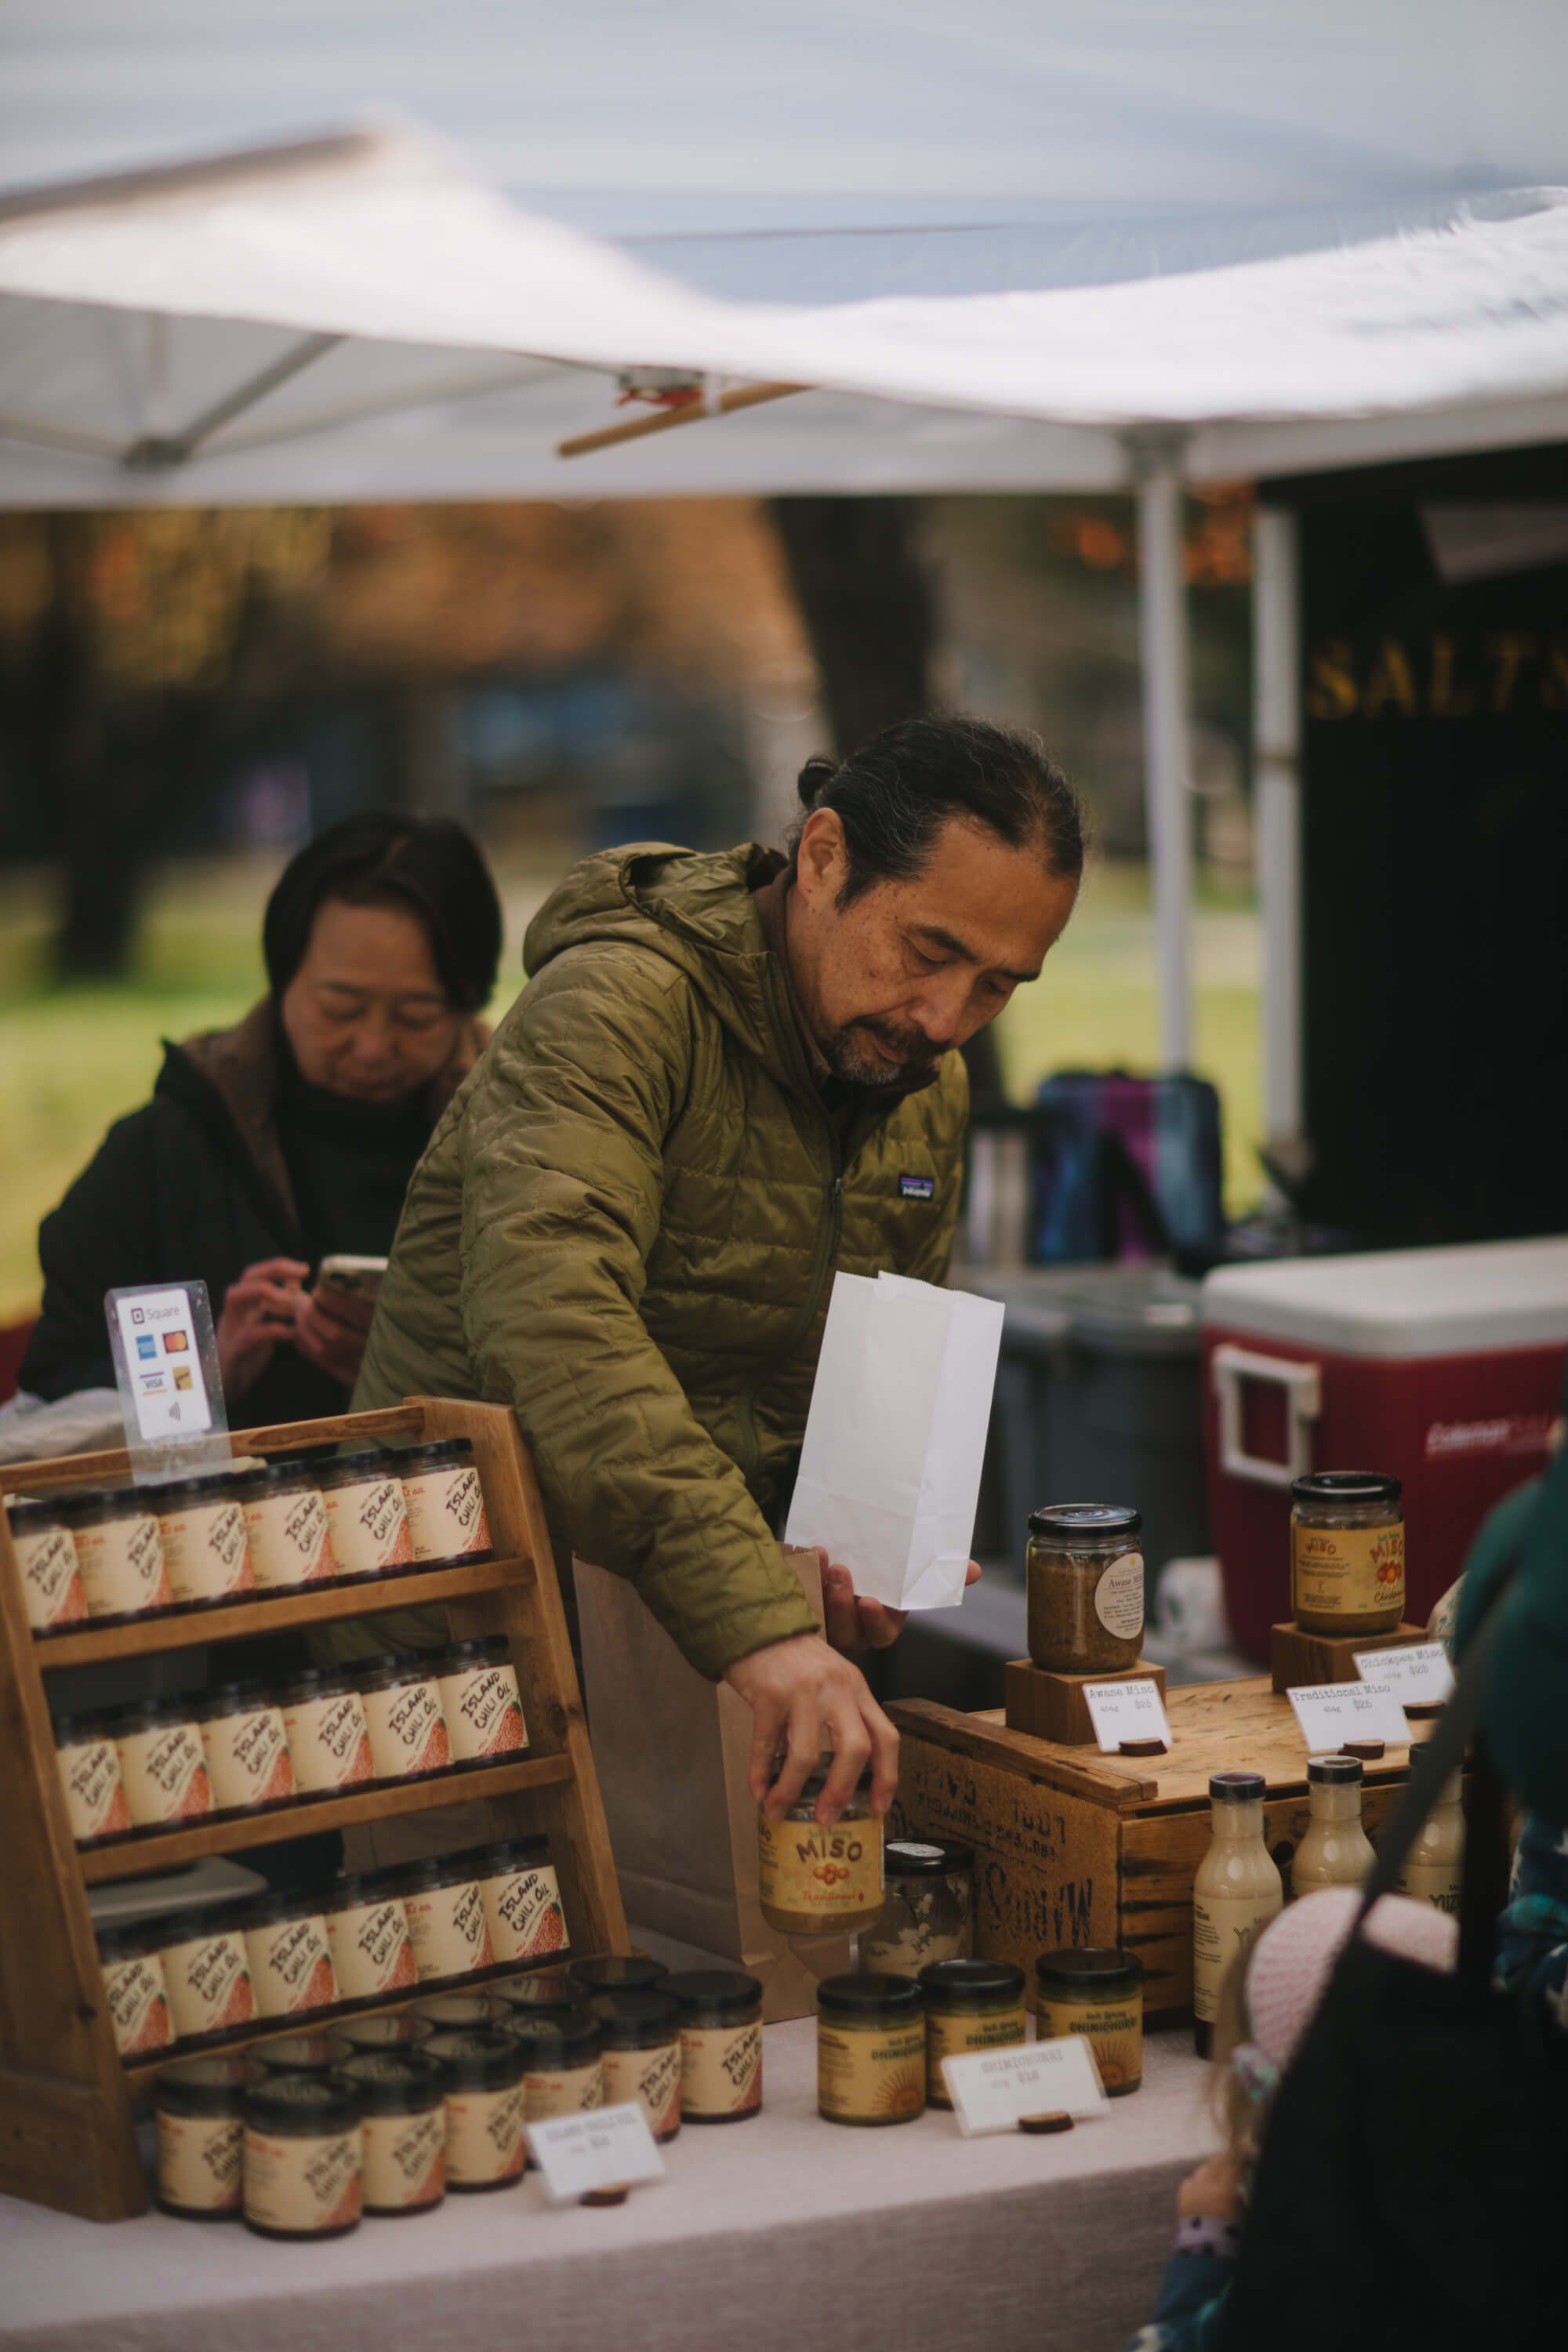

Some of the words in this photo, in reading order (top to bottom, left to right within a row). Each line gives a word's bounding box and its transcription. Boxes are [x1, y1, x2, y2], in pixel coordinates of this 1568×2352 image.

[147, 1307, 180, 1320] Square
[144, 1378, 163, 1388] VISA
[359, 1483, 396, 1530] ISLAND
[445, 1470, 477, 1515] ISLAND
[373, 1508, 396, 1542] CHILI
[458, 1497, 477, 1527] CHILI
[1306, 1541, 1338, 1555] MISO
[1370, 1537, 1403, 1564] MISO
[1108, 1578, 1131, 1588] Awase
[1360, 1653, 1413, 1670] Chickpea
[1415, 1648, 1443, 1661] Miso
[460, 1671, 501, 1719] ISLAND
[474, 1698, 497, 1730] CHILI
[496, 1681, 512, 1700] OIL
[1088, 1688, 1123, 1699] Awase
[1125, 1685, 1155, 1696] Miso
[1291, 1686, 1361, 1702] Traditional
[1364, 1683, 1391, 1696] Miso
[318, 1699, 355, 1748] ISLAND
[388, 1686, 427, 1736] ISLAND
[231, 1714, 271, 1764] ISLAND
[331, 1727, 354, 1759] CHILI
[401, 1712, 425, 1745] CHILI
[145, 1730, 187, 1779] ISLAND
[247, 1739, 270, 1776] CHILI
[160, 1755, 185, 1792] CHILI
[796, 1837, 863, 1864] MISO
[497, 1872, 539, 1922] ISLAND
[511, 1900, 536, 1933] CHILI
[534, 1882, 550, 1902] OIL
[802, 1889, 857, 1902] Traditional
[358, 1905, 395, 1955] ISLAND
[187, 1939, 229, 1990] ISLAND
[269, 1922, 310, 1974] ISLAND
[372, 1932, 394, 1966] CHILI
[283, 1949, 308, 1985] CHILI
[201, 1967, 227, 2002] CHILI
[731, 2054, 755, 2087] CHILI
[981, 2048, 1065, 2074] CHIMICHURRI
